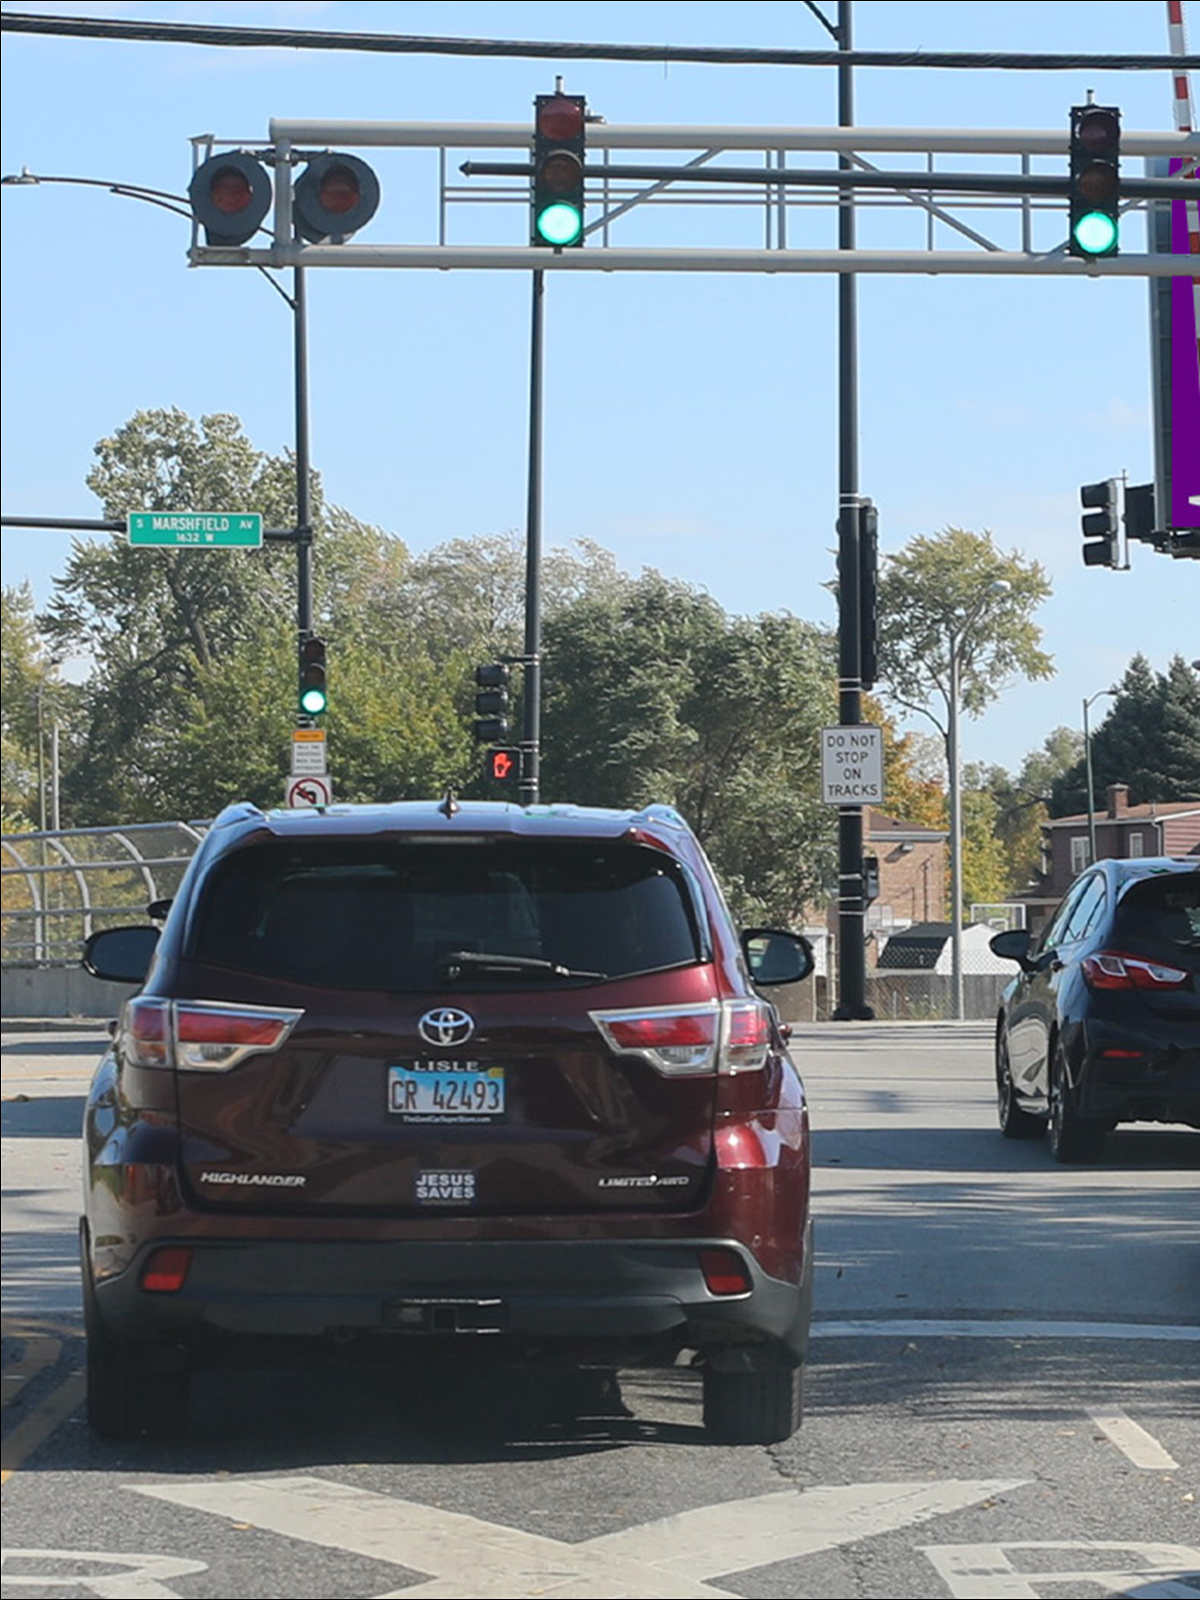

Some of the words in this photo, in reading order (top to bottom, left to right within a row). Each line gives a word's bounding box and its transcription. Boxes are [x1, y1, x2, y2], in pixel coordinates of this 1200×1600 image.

[136, 518, 144, 529] S
[152, 517, 230, 532] MARSHFIELD
[239, 520, 254, 530] AV
[205, 533, 215, 542] W
[827, 735, 845, 748] DO
[851, 734, 876, 747] NOT
[836, 751, 869, 764] STOP
[843, 767, 862, 780] ON
[827, 783, 878, 797] TRACKS
[414, 1061, 479, 1072] LISLE
[391, 1080, 418, 1110] CR
[432, 1080, 501, 1110] 42493
[201, 1172, 306, 1187] HIGHLANDER
[416, 1174, 475, 1186] JESUS
[416, 1186, 475, 1198] SAVES
